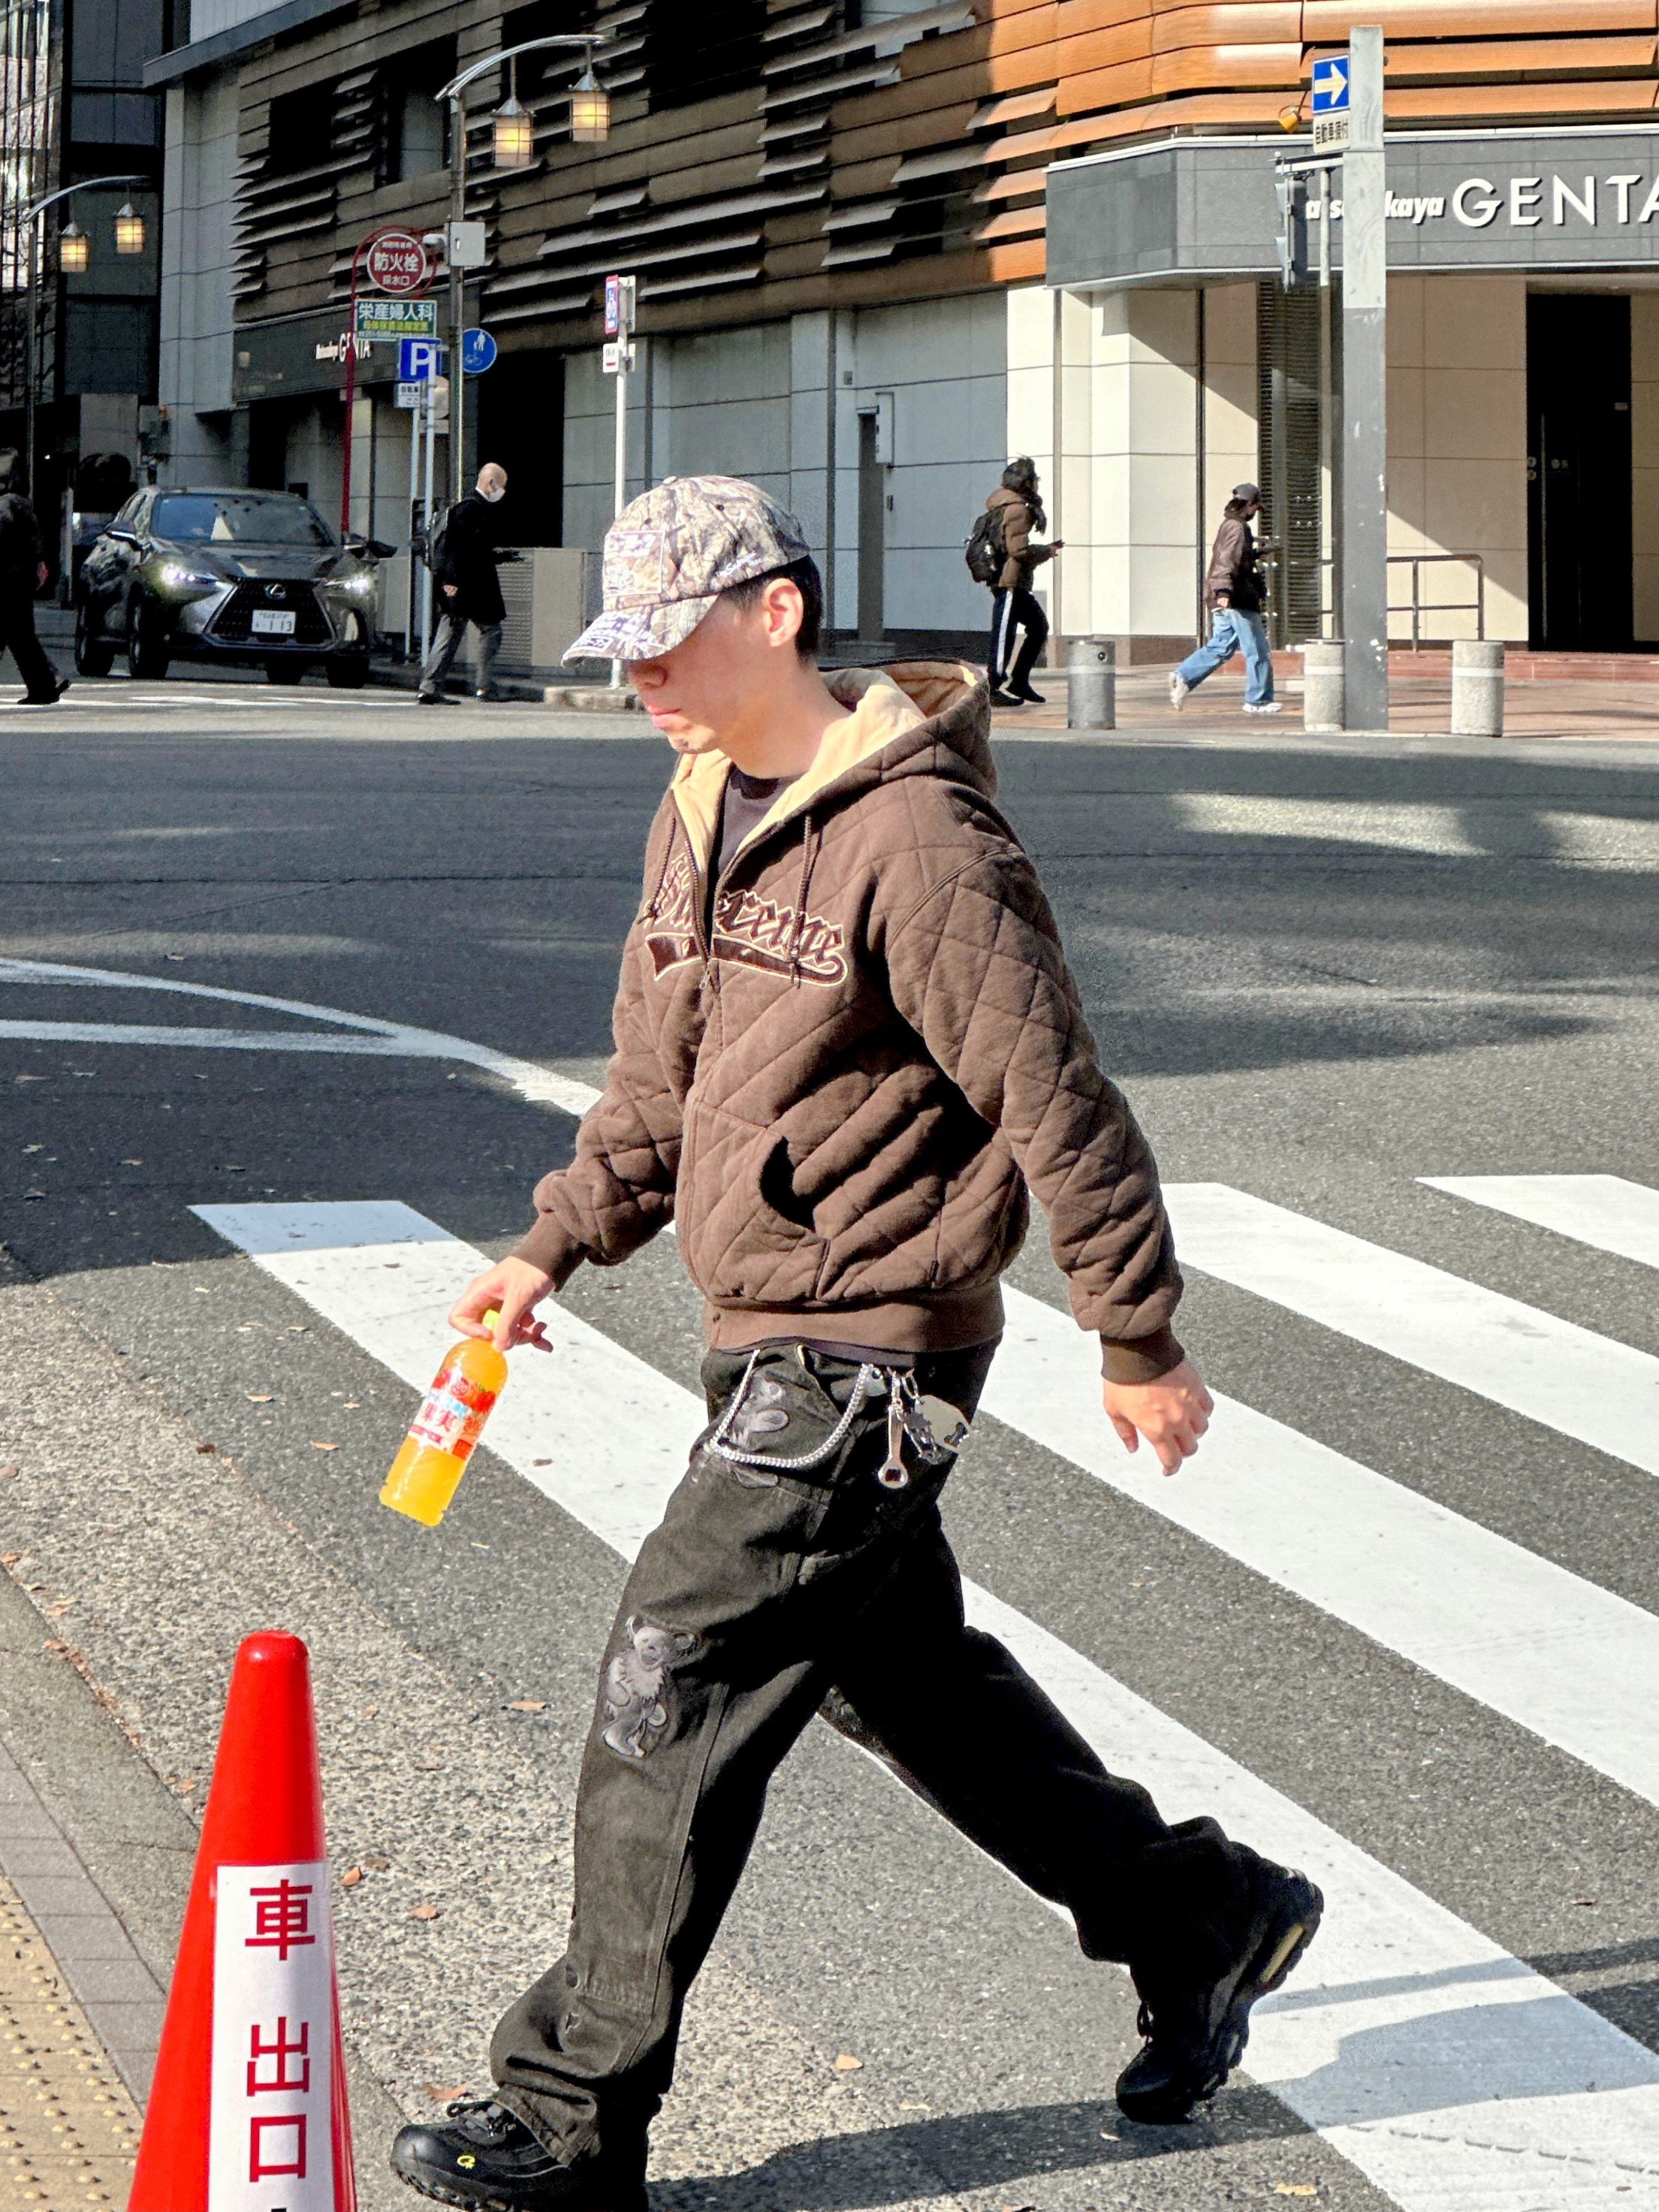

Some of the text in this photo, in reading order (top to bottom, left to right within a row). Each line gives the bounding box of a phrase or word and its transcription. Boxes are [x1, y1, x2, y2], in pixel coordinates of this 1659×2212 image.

[358, 303, 433, 321] 栄産婦人科
[410, 343, 435, 376] P
